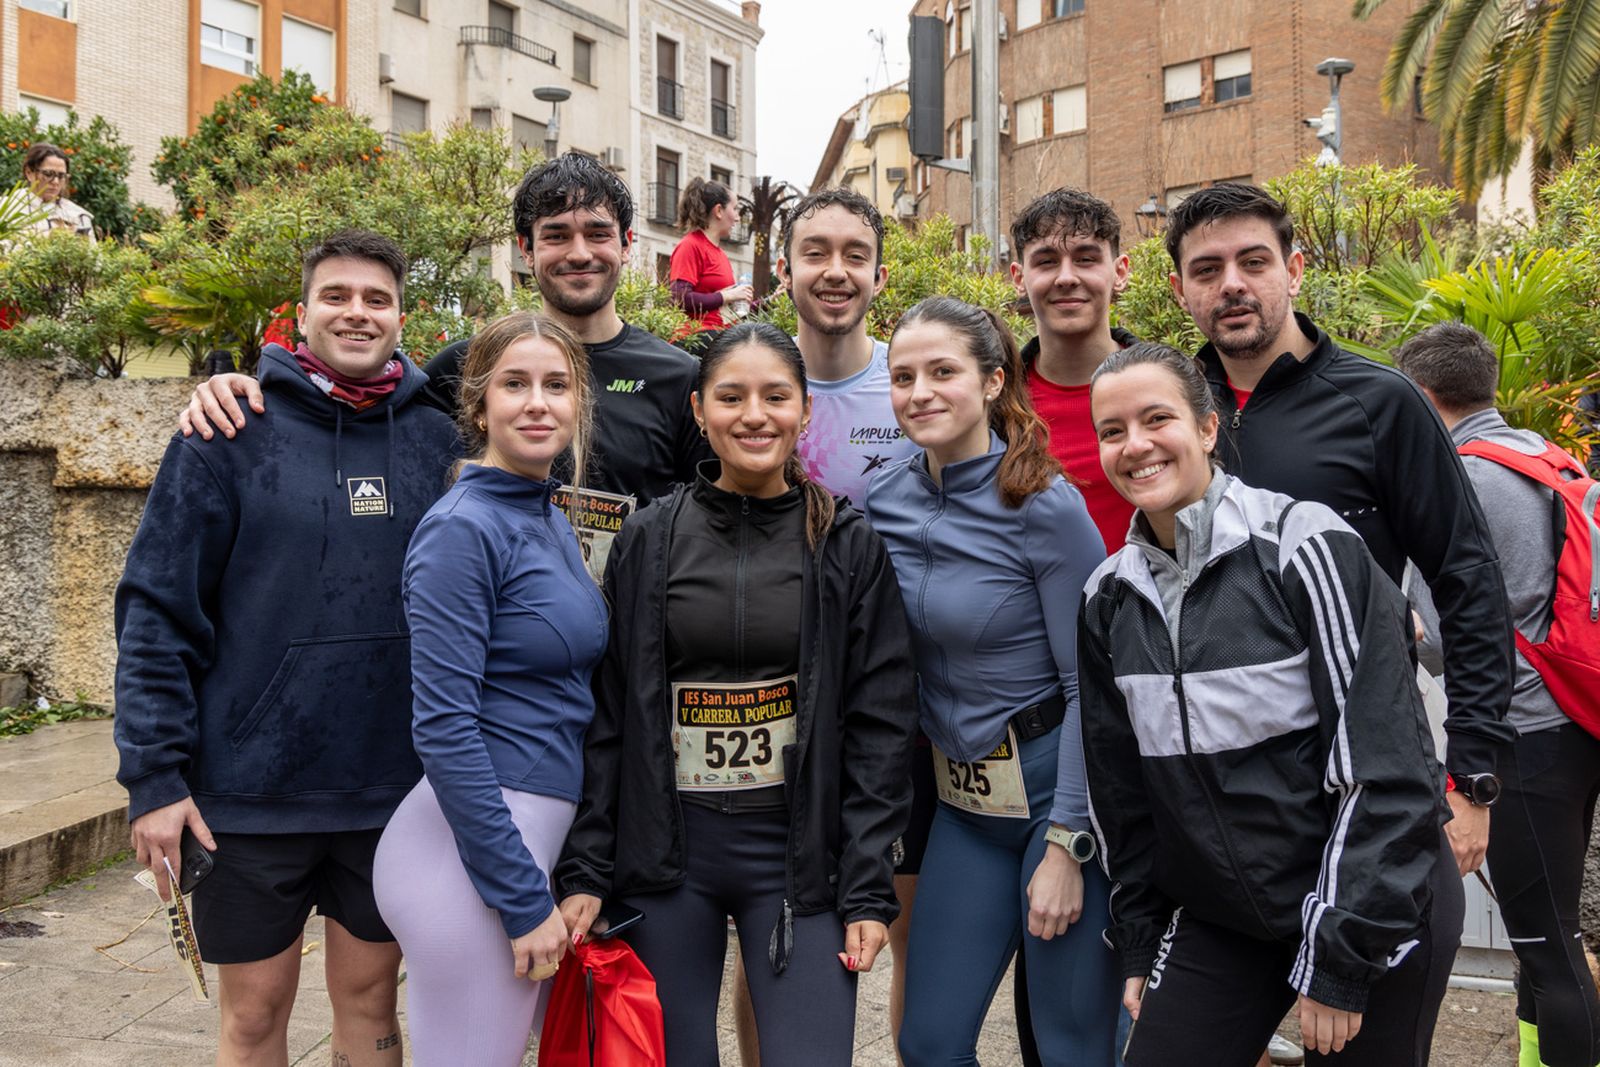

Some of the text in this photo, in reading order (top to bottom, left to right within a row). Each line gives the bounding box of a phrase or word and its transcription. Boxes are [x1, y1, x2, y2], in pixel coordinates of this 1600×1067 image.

[606, 379, 635, 393] JM
[576, 510, 623, 531] POPULAR
[684, 685, 789, 706] IES San Juan Bosco
[682, 699, 792, 724] V CARRERA POPULAR
[705, 727, 773, 770] 523
[947, 757, 992, 797] 525
